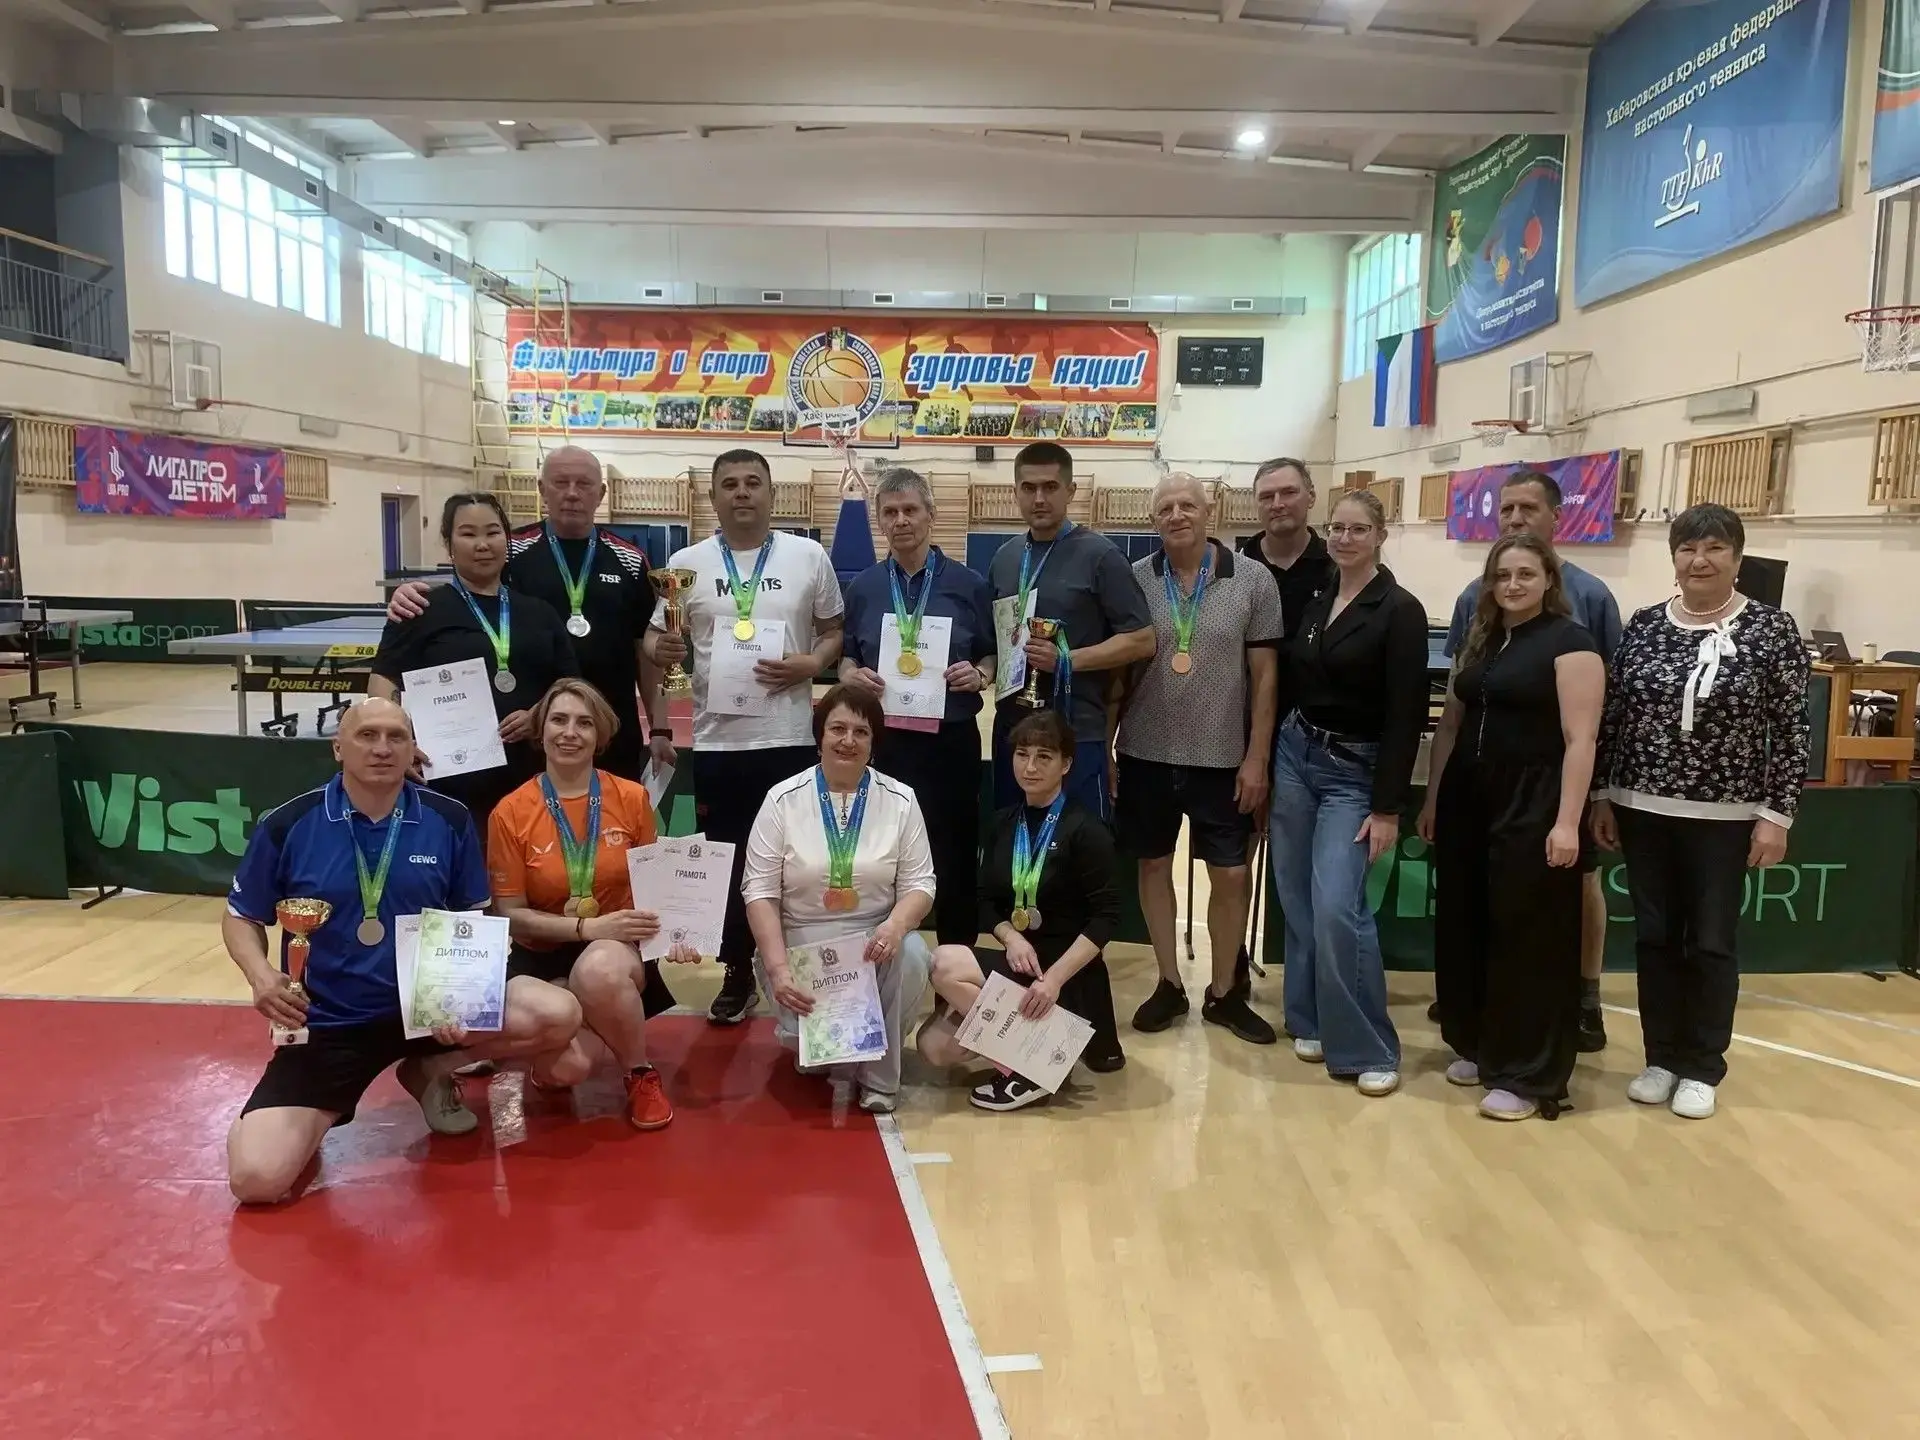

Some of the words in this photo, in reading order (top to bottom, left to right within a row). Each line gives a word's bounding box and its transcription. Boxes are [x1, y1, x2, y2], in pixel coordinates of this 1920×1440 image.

[1709, 43, 1766, 91] тенниса
[1605, 72, 1674, 129] Хабаровская
[671, 350, 688, 376] и
[700, 351, 769, 380] спорт
[905, 352, 1036, 392] здоровье
[1050, 350, 1149, 389] нации!
[168, 481, 236, 503] ДЕТЯМ
[733, 642, 762, 652] ГРАМОТА
[267, 677, 320, 690] DOUBLE
[322, 680, 352, 691] FISH
[433, 692, 467, 705] ГРАМОТА
[73, 773, 272, 857] Vist
[675, 869, 707, 880] ГРАМОТА
[435, 947, 488, 959] ДИПЛОМ
[812, 971, 859, 990] ДИПЛОМ
[997, 1010, 1018, 1039] ГРАМОТА
